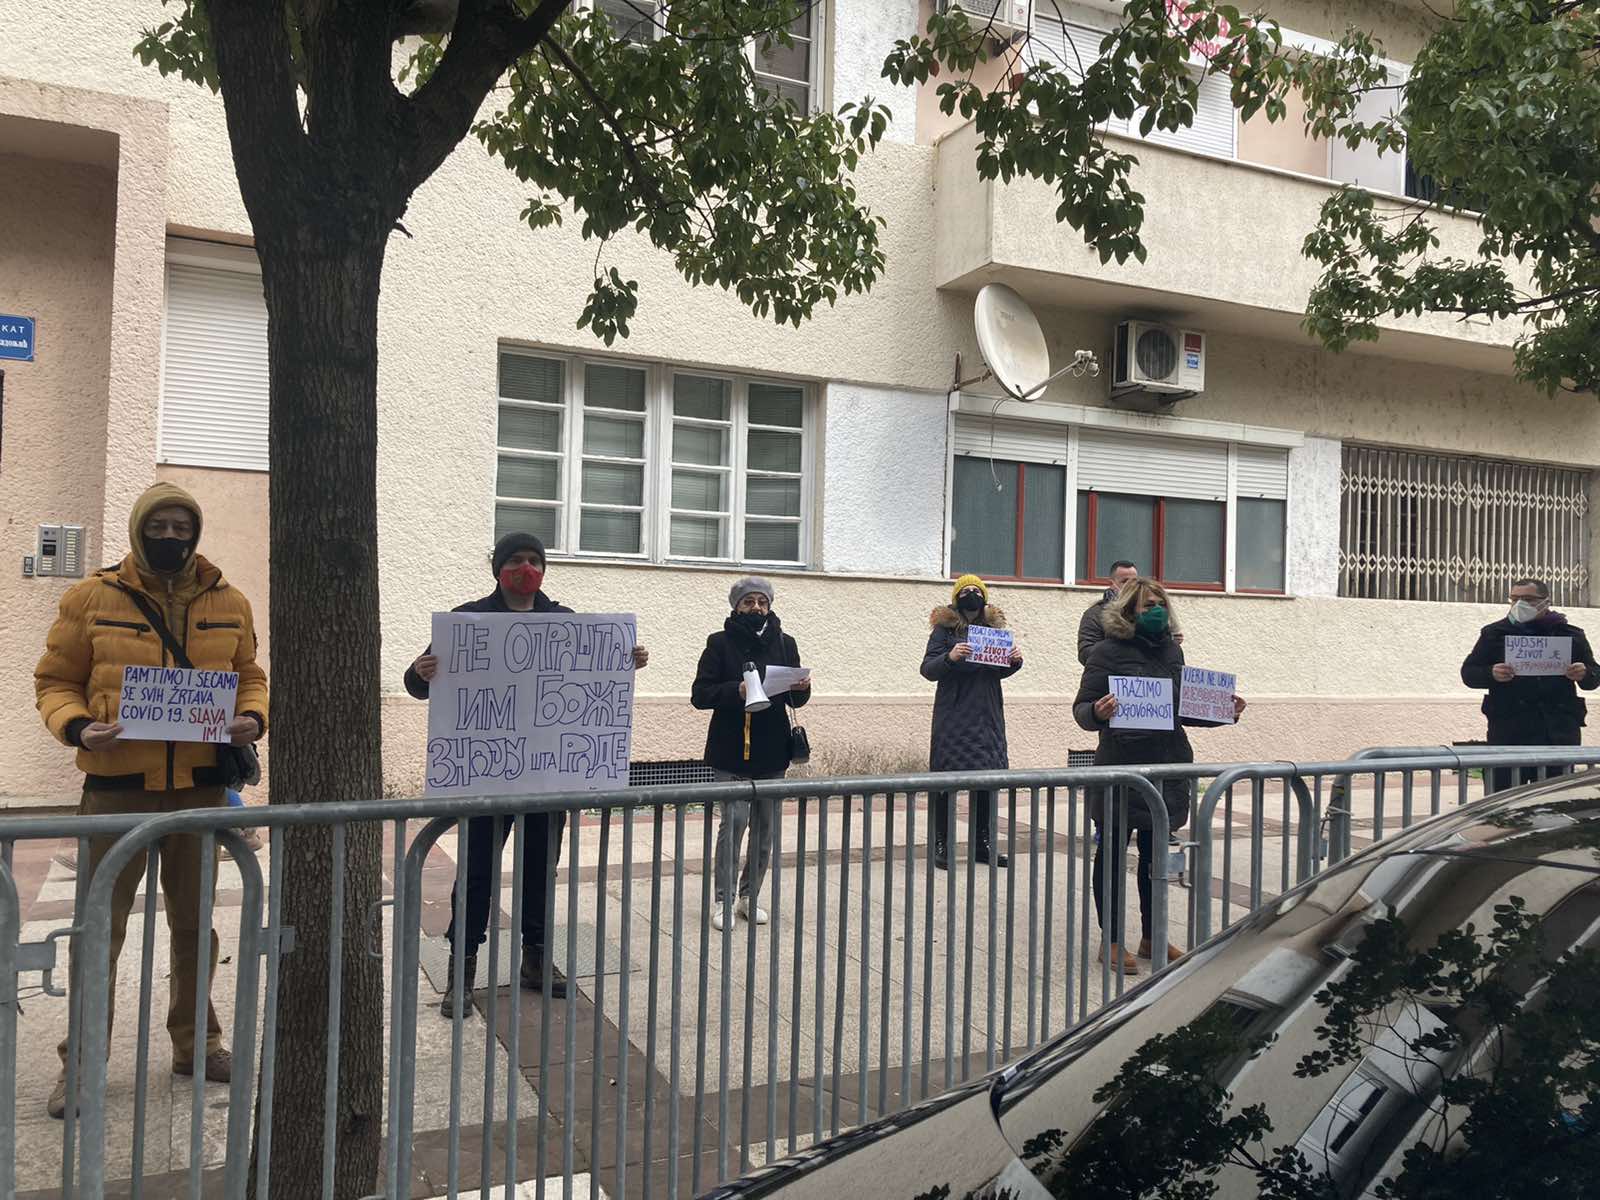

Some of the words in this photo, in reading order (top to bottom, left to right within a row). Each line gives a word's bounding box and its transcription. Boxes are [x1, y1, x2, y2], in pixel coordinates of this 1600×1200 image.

[449, 623, 491, 673] НЕ
[124, 666, 184, 685] PAMTIMO
[187, 670, 193, 686] I
[121, 685, 137, 701] SE
[141, 686, 164, 703] SVIH
[167, 685, 215, 706] ŽRTAVA
[1113, 677, 1162, 698] TRAŽIMO
[455, 684, 517, 731] ИМ
[533, 674, 632, 728] БОЖЕ
[121, 704, 164, 721] COVID
[188, 707, 226, 725] SLAVA
[558, 732, 628, 779] РАДЕ
